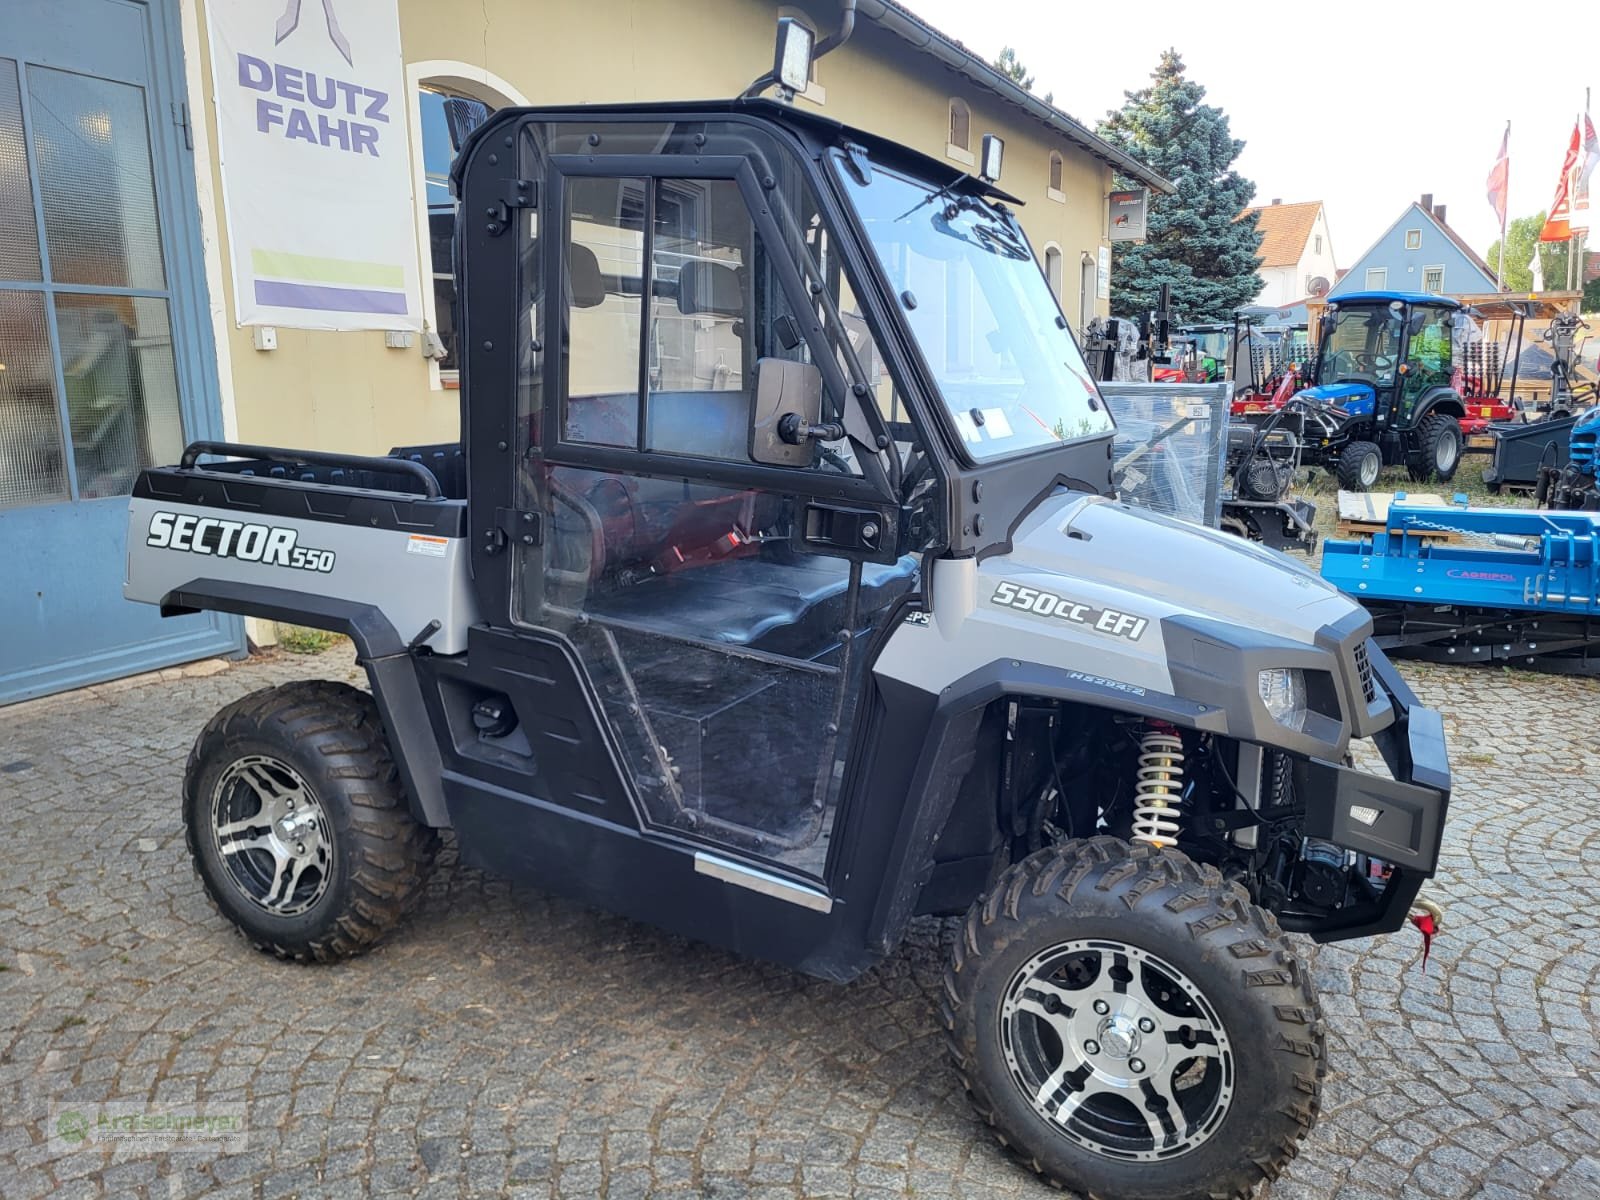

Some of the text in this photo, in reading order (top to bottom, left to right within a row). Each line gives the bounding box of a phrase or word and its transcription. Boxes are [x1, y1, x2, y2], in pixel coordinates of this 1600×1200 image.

[237, 52, 389, 123] DEUTZ
[256, 98, 380, 157] FAHR
[147, 511, 336, 573] SECTOR 550
[1095, 610, 1147, 639] EFI
